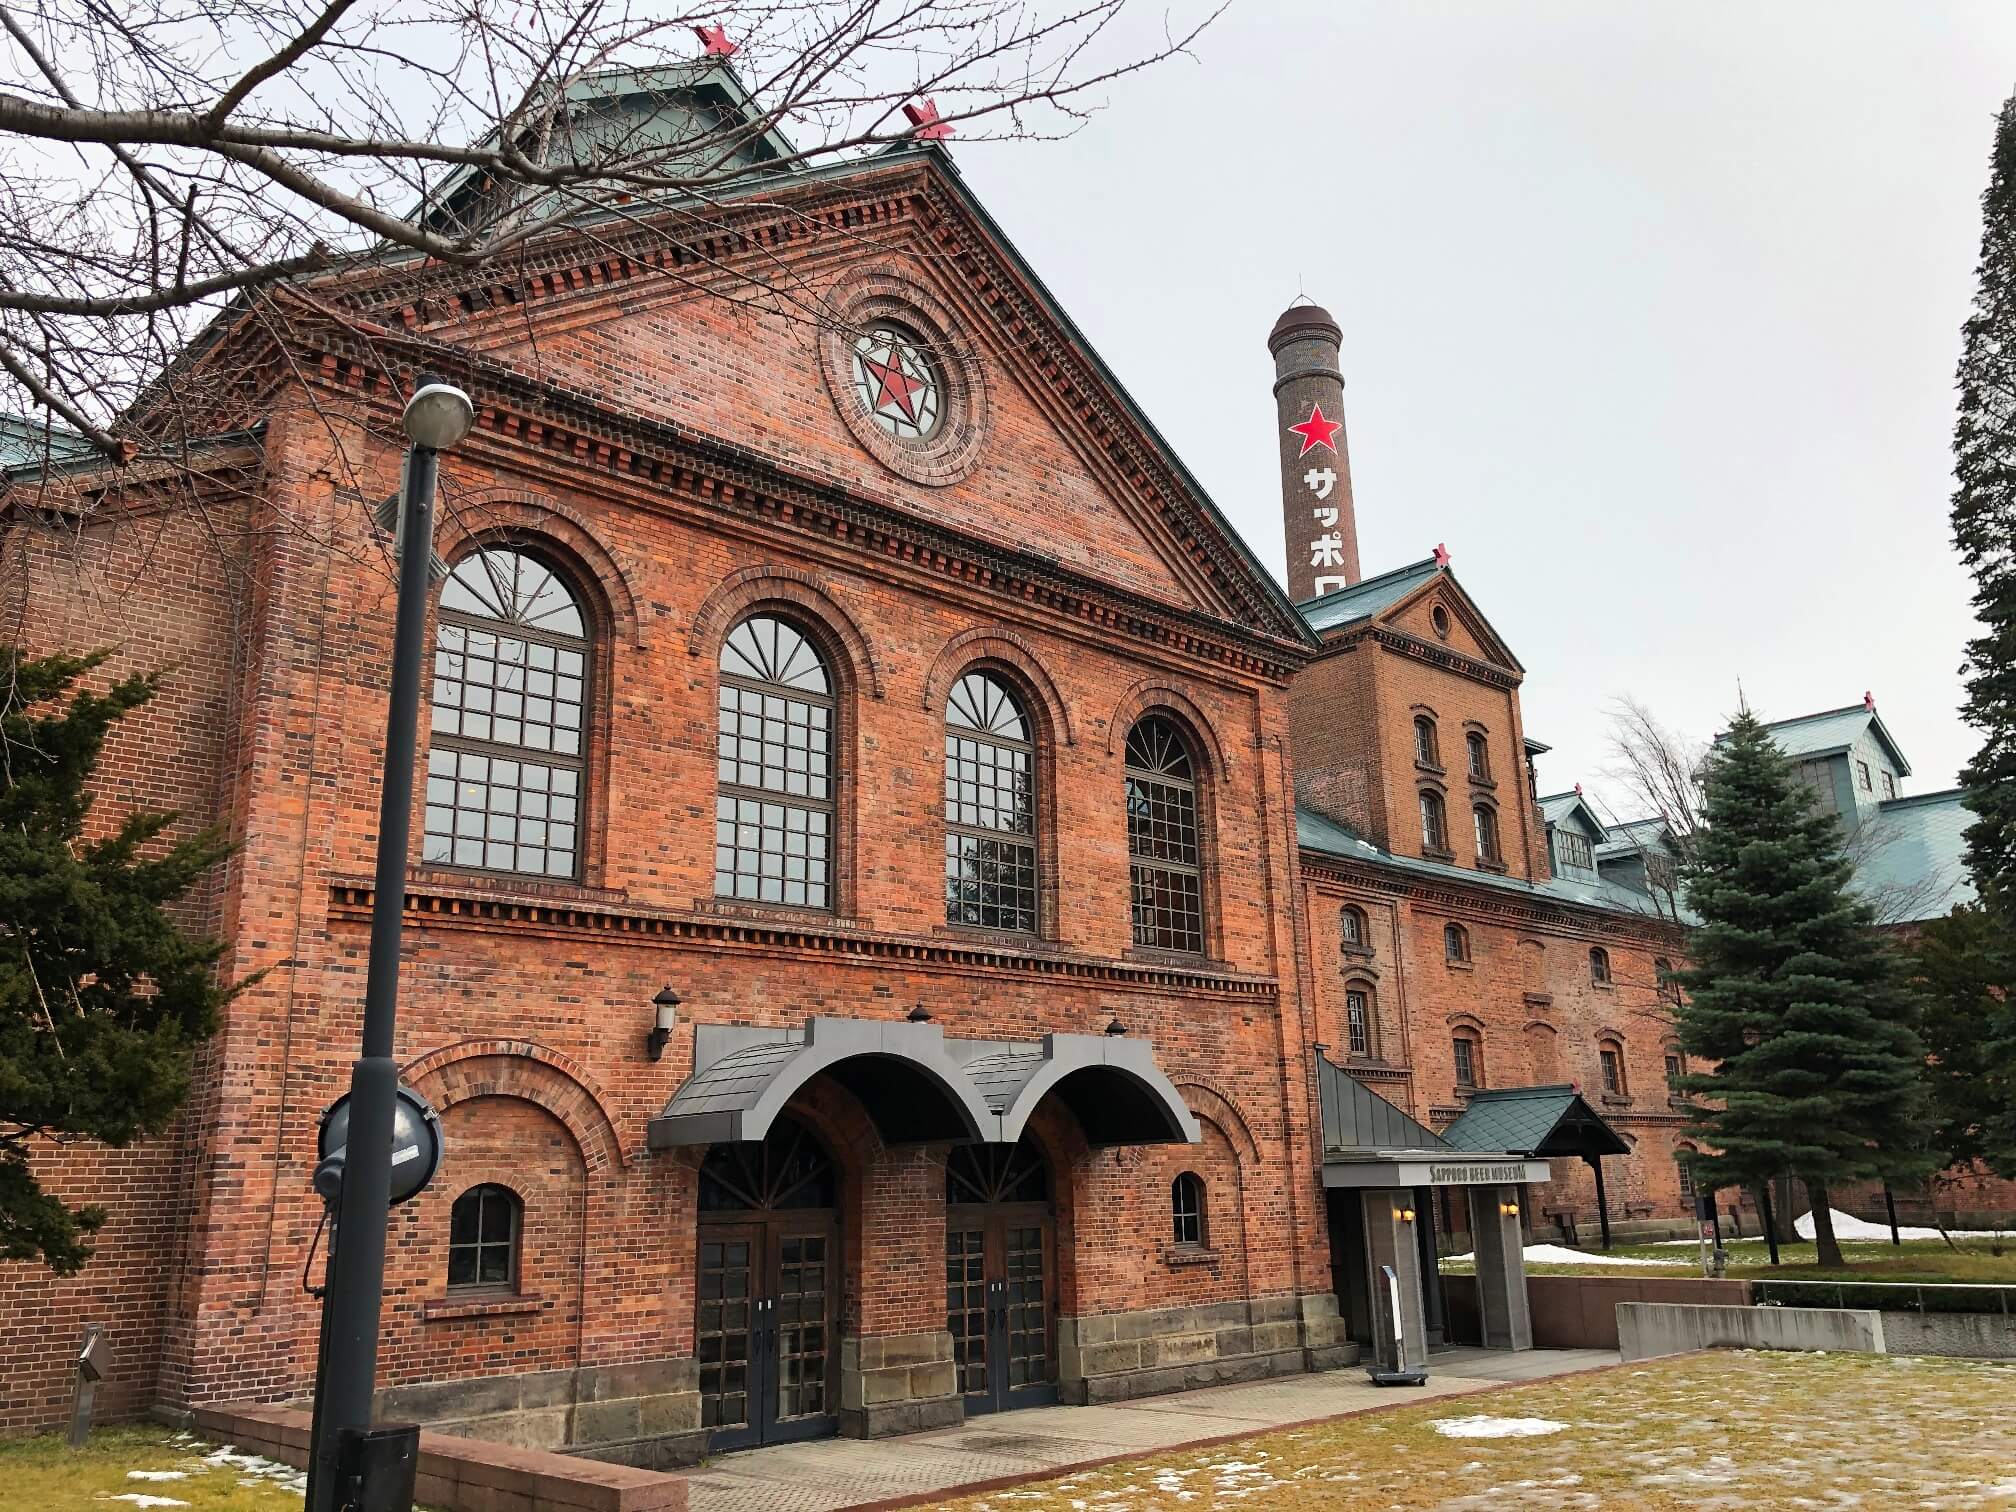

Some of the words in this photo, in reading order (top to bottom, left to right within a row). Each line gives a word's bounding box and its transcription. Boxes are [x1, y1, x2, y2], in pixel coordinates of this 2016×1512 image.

[1429, 1165, 1468, 1183] SAPPORO
[1469, 1167, 1490, 1182] BEER
[1491, 1163, 1526, 1181] MUSEUM
